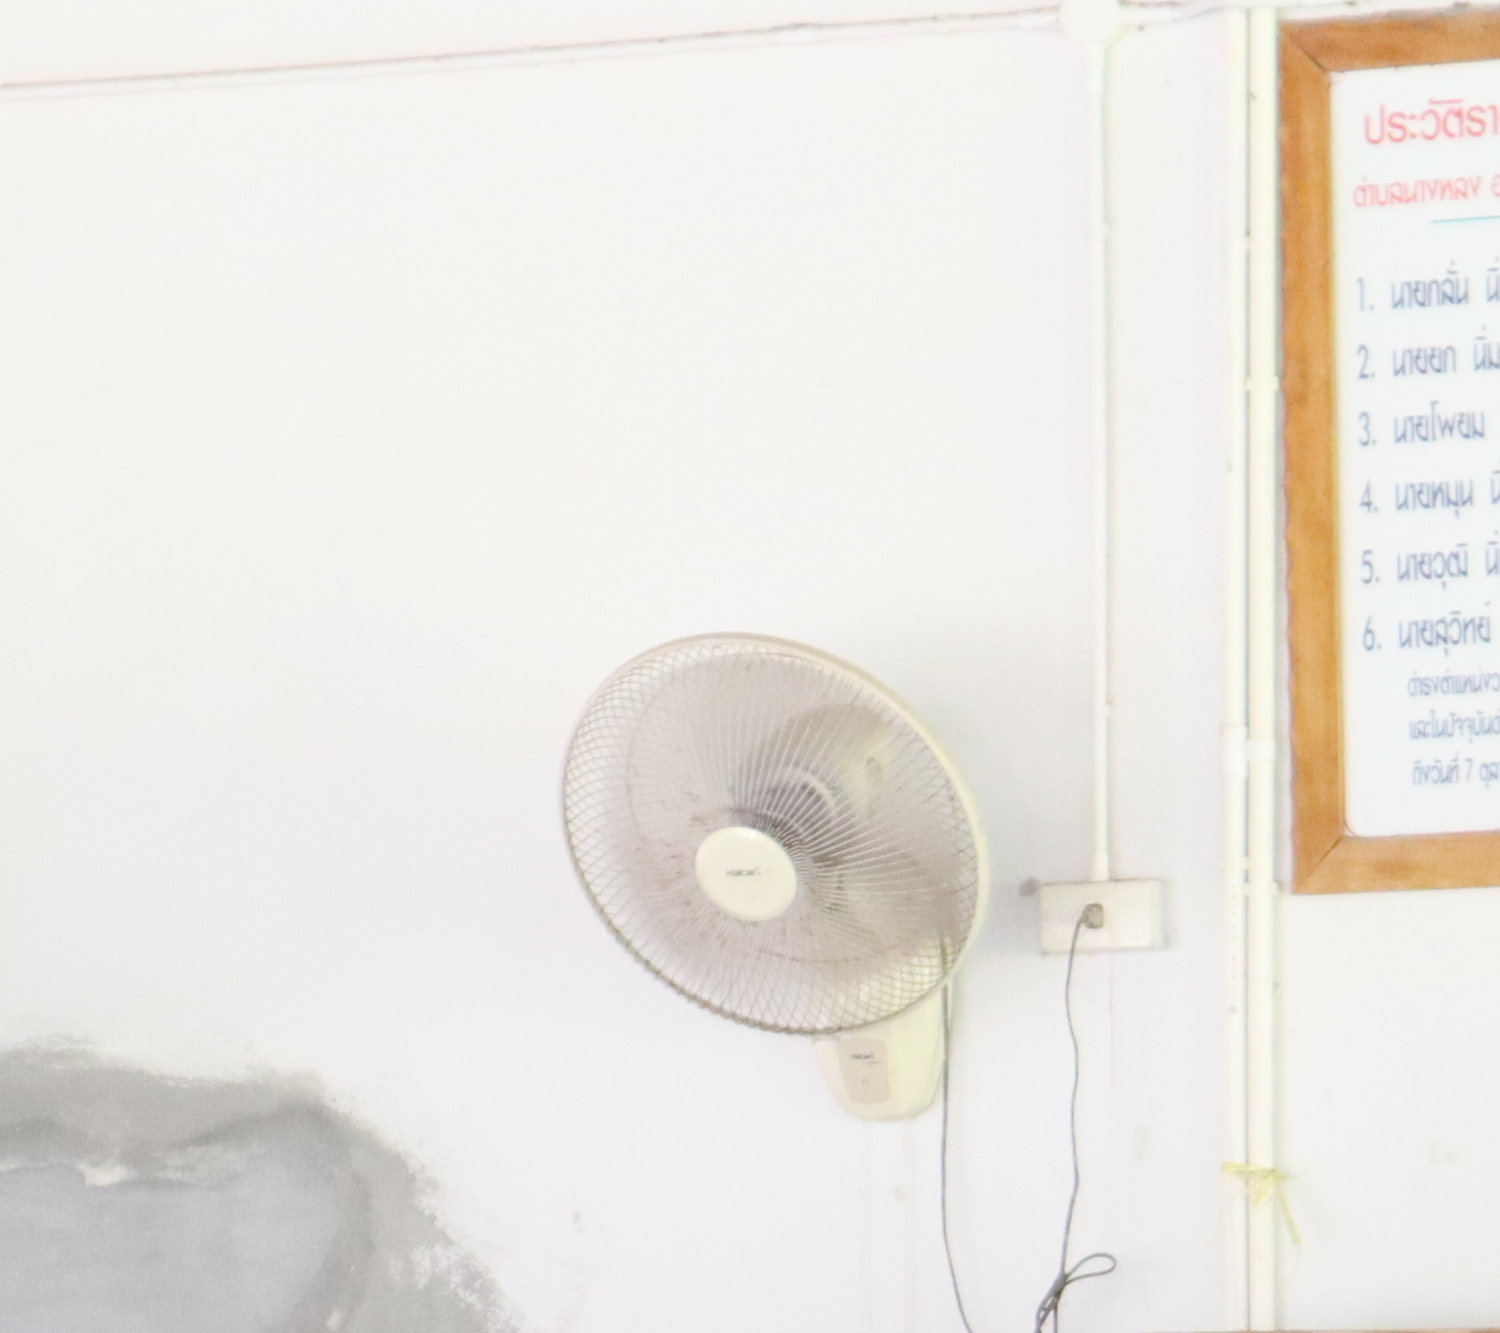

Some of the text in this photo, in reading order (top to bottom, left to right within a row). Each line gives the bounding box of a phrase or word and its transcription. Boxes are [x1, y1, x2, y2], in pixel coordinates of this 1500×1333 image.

[1357, 276, 1374, 311] 1.
[1356, 343, 1375, 380] 2.
[1358, 410, 1377, 448] 3.
[1358, 480, 1378, 513] 4.
[1360, 548, 1380, 585] 5.
[1361, 615, 1382, 652] 6.
